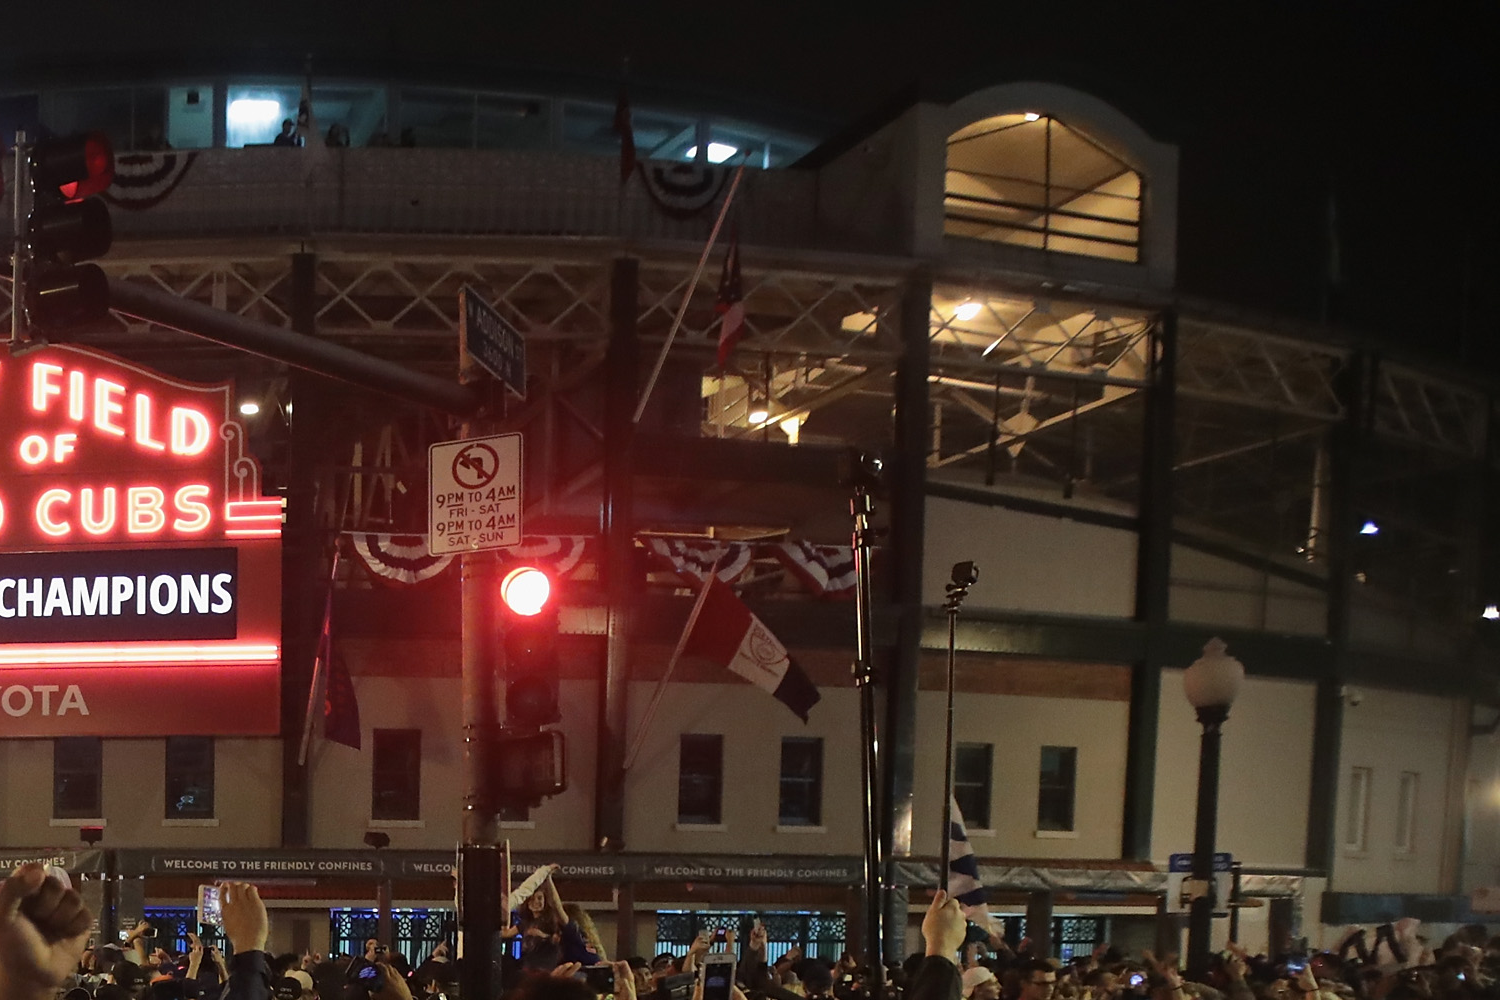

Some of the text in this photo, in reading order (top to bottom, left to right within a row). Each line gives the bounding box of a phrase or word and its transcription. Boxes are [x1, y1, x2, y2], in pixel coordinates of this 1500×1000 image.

[31, 361, 212, 456] FIELD
[20, 433, 78, 464] OF
[468, 491, 482, 502] TO
[35, 484, 212, 536] CUBS
[449, 508, 468, 518] FRI
[479, 503, 501, 514] SAT
[468, 519, 482, 531] TO
[448, 535, 470, 546] SAT
[479, 532, 503, 542] SUN
[164, 859, 373, 871] WELCOME TO THE FRIENDLY CONFINES
[562, 865, 615, 875] CONFINES
[654, 866, 847, 878] WELCOME TO THE FRIENDLY CONFINES
